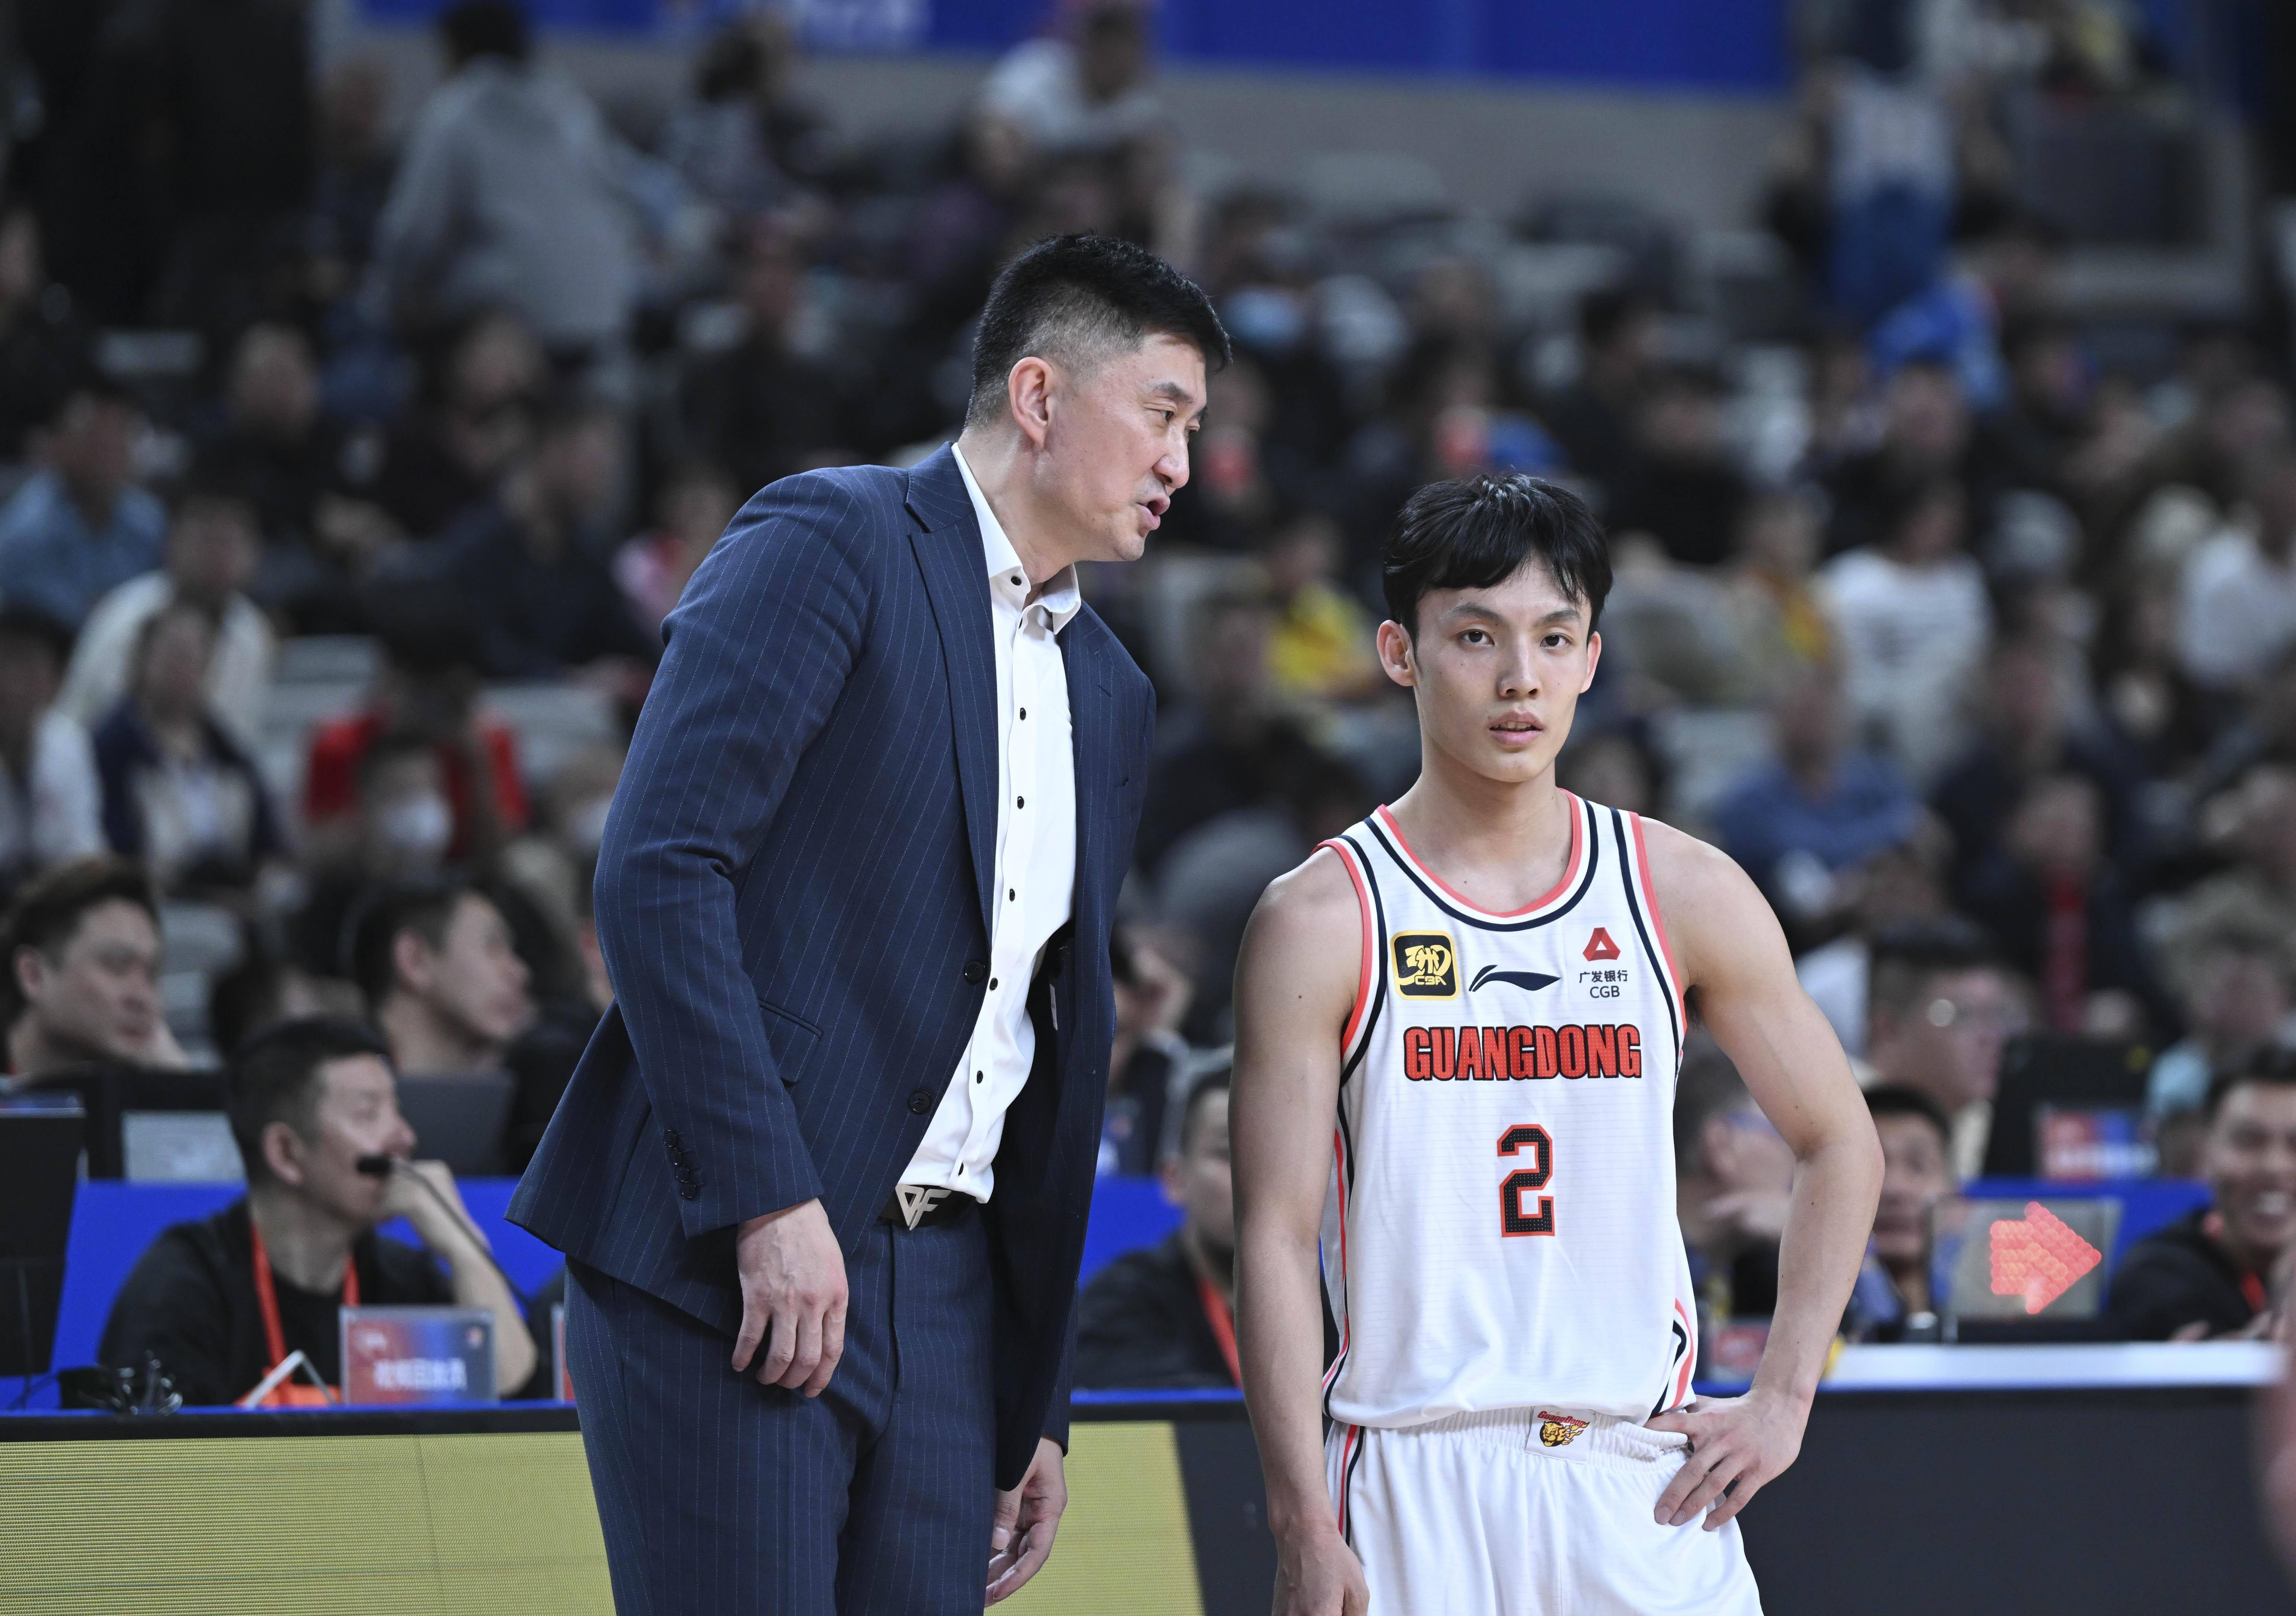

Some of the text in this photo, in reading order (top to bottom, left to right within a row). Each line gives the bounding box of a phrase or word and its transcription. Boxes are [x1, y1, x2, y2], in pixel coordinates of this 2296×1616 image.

[1415, 975, 1447, 985] CBA
[1579, 970, 1628, 983] 广发银行
[1590, 985, 1620, 998] CGB
[1403, 1024, 1642, 1081] GUANGDONG
[1497, 1124, 1555, 1237] 2
